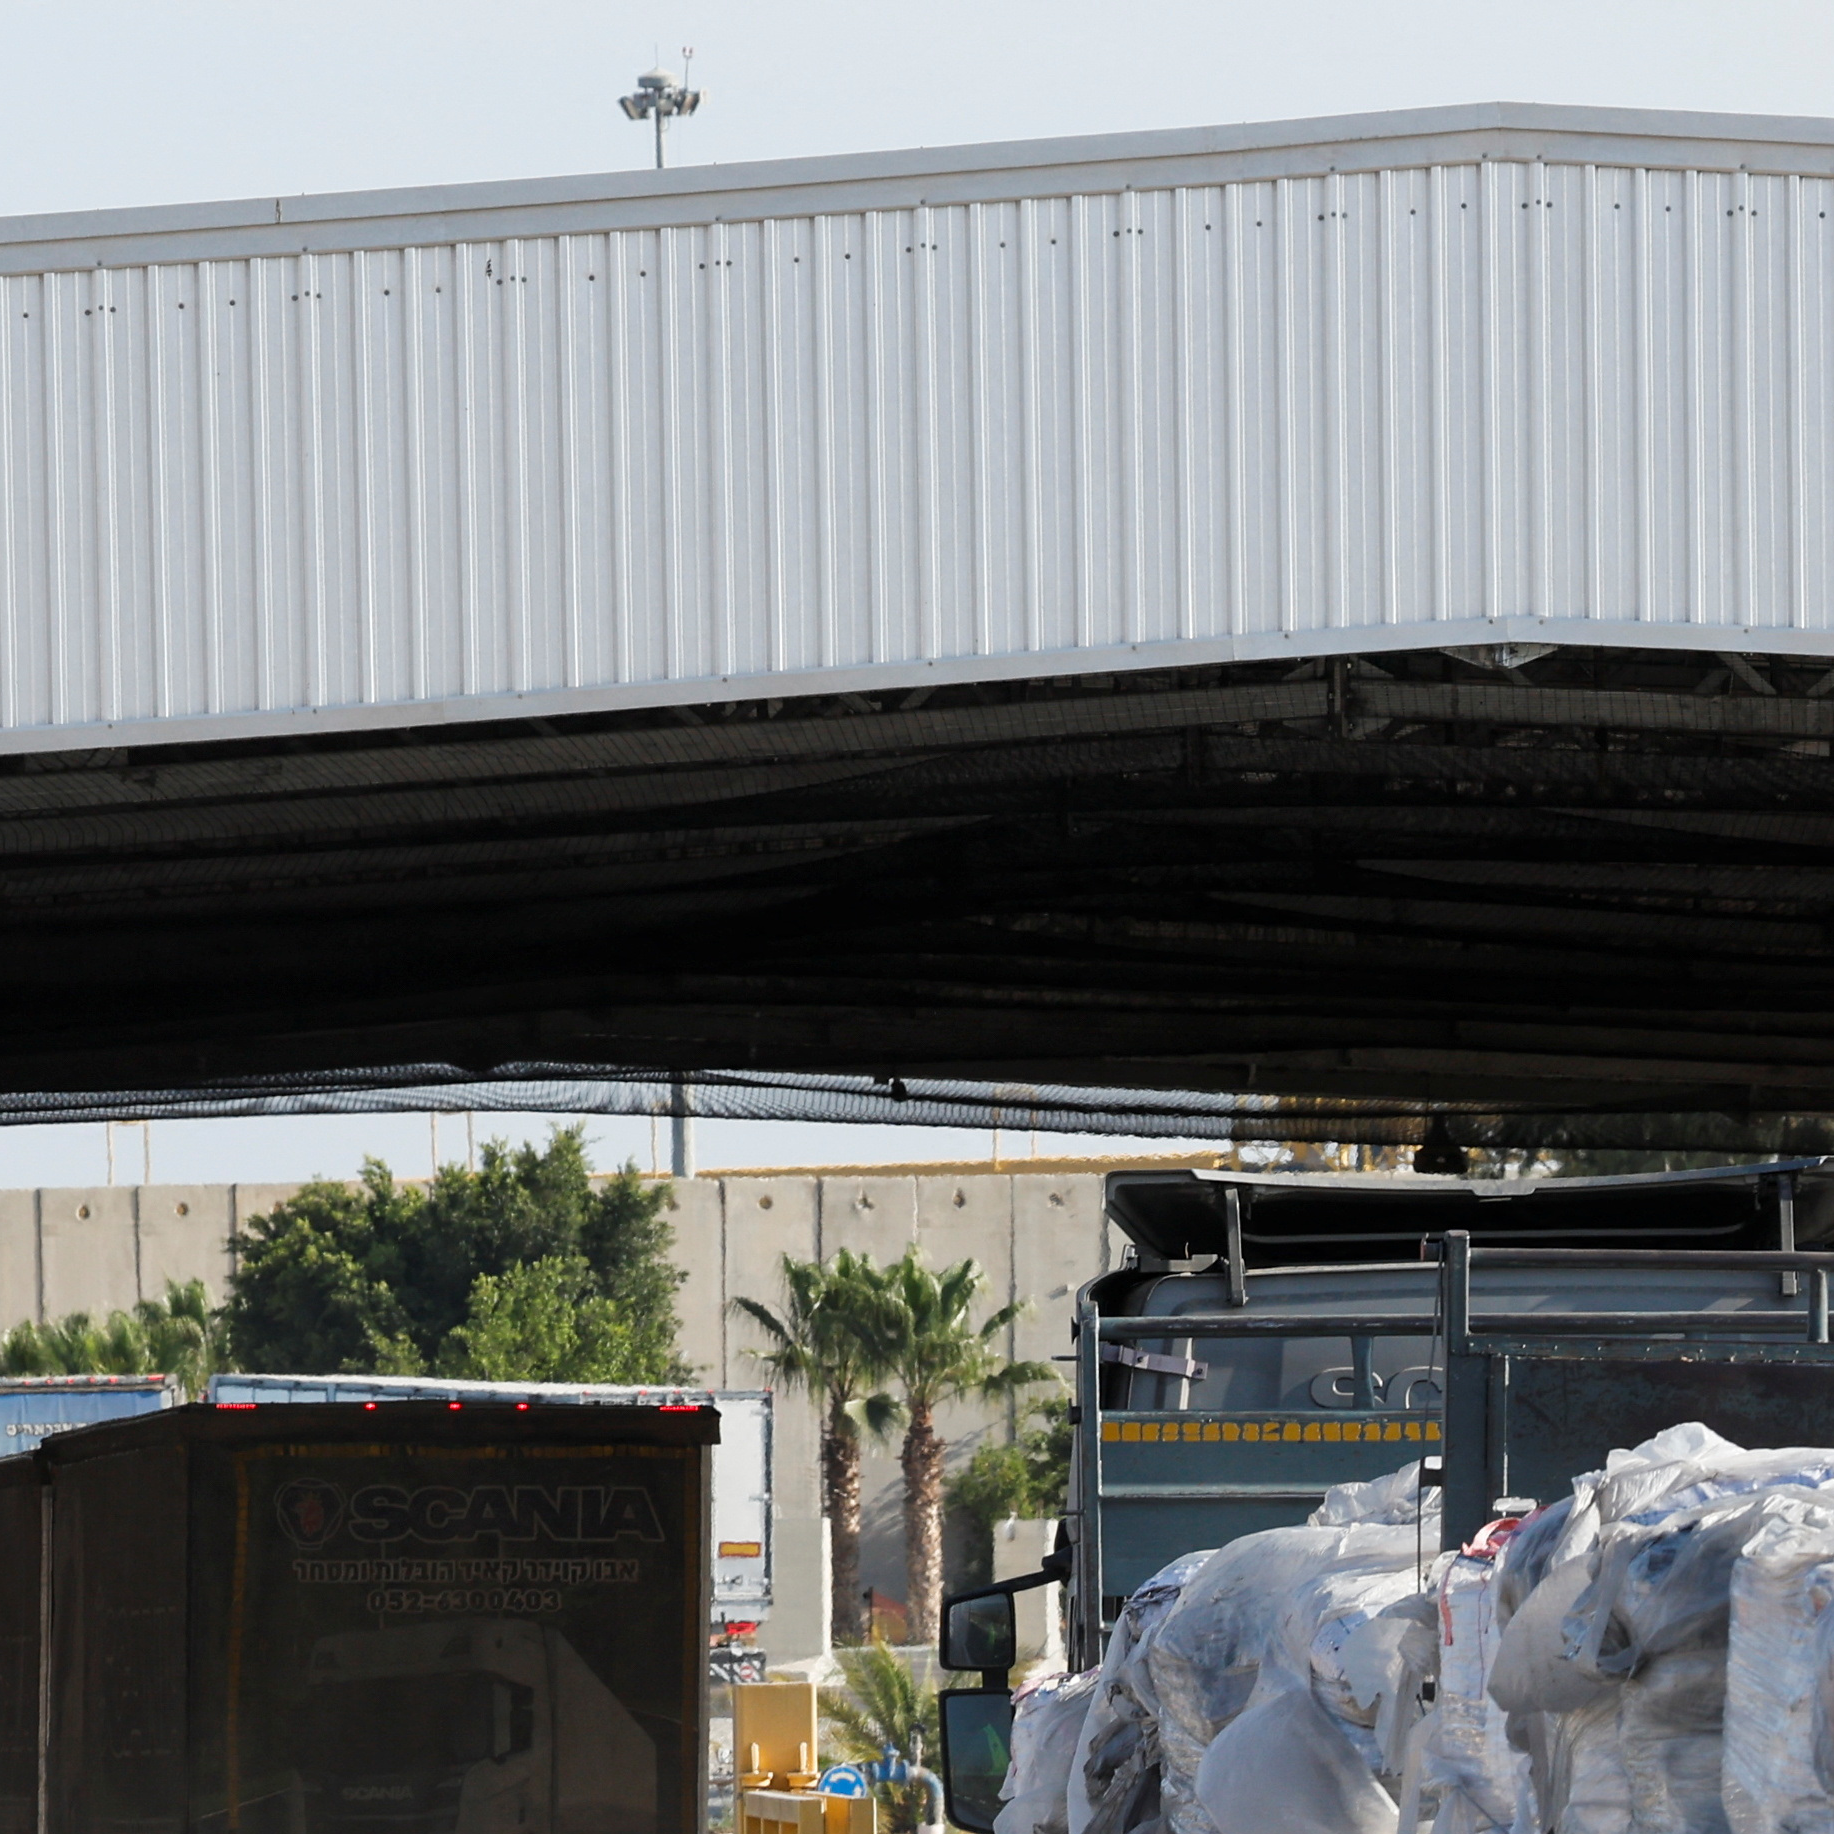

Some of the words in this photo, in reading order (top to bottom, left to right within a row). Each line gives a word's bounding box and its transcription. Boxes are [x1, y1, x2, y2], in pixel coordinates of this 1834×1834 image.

[348, 1484, 666, 1543] SCANIA
[293, 1558, 371, 1584] ומסחר
[374, 1556, 457, 1584] הובלות
[459, 1558, 520, 1586] קאיד
[594, 1558, 640, 1583] אבו
[367, 1589, 563, 1613] 052-6300403
